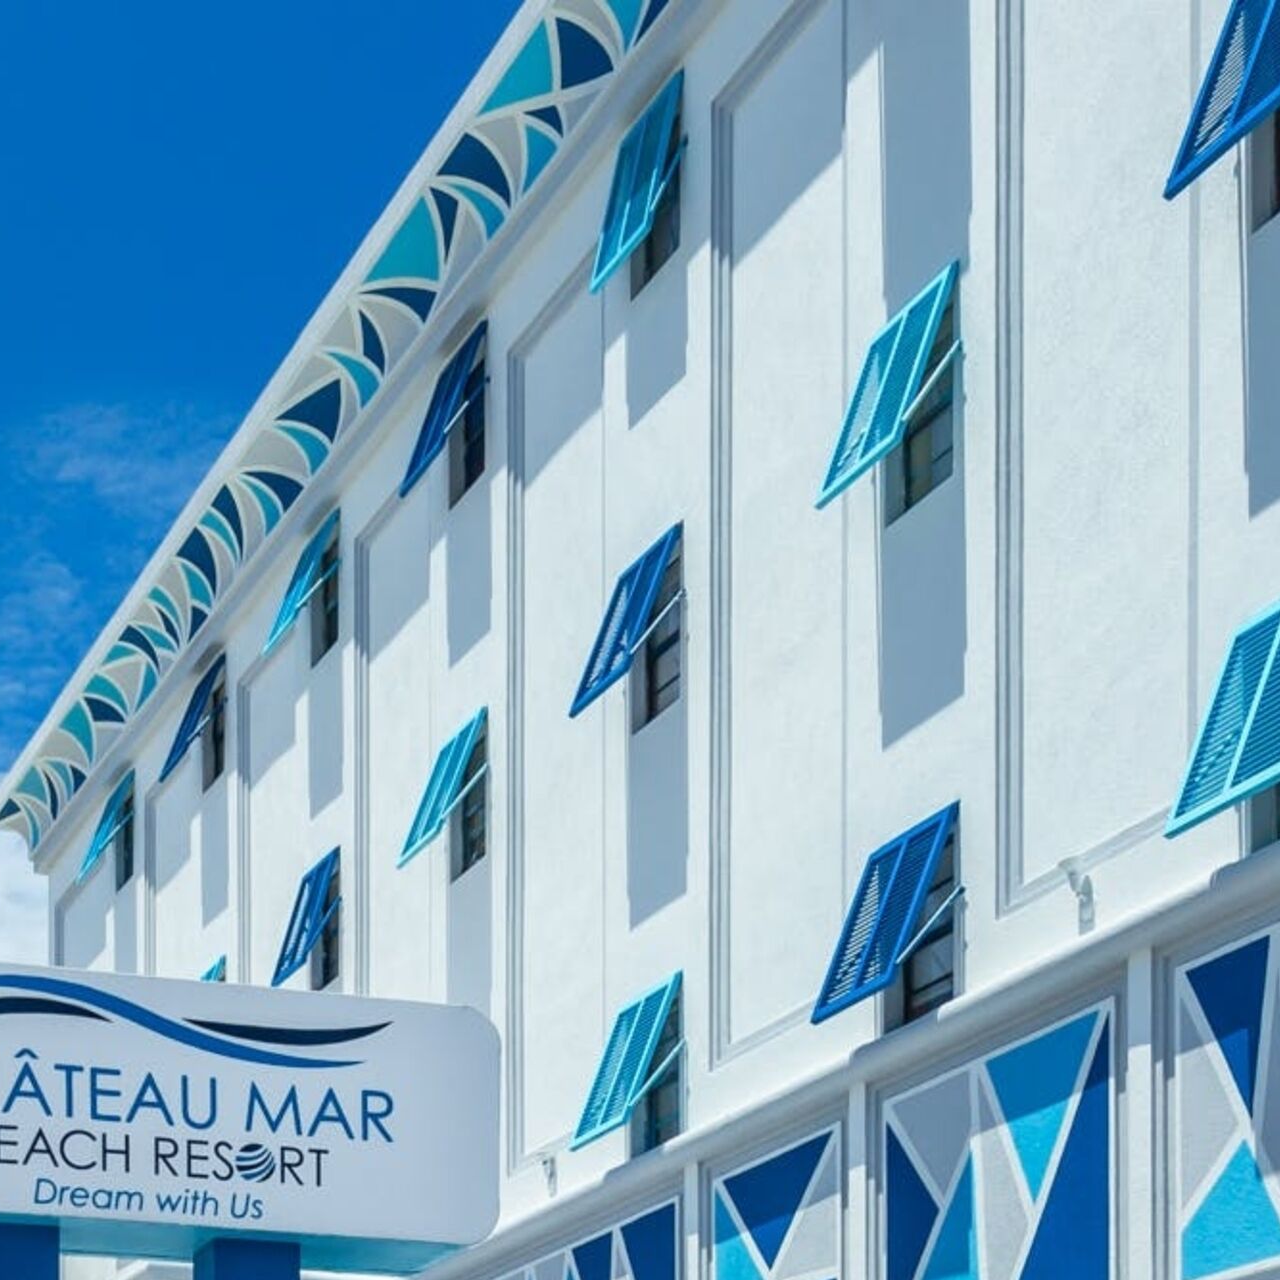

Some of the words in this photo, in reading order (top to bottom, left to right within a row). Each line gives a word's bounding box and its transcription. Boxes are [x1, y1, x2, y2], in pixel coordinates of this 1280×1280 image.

[245, 1081, 394, 1143] MAR
[154, 1136, 329, 1187] RESORT
[34, 1178, 145, 1212] Dream
[156, 1188, 219, 1217] with
[230, 1192, 264, 1219] Us
